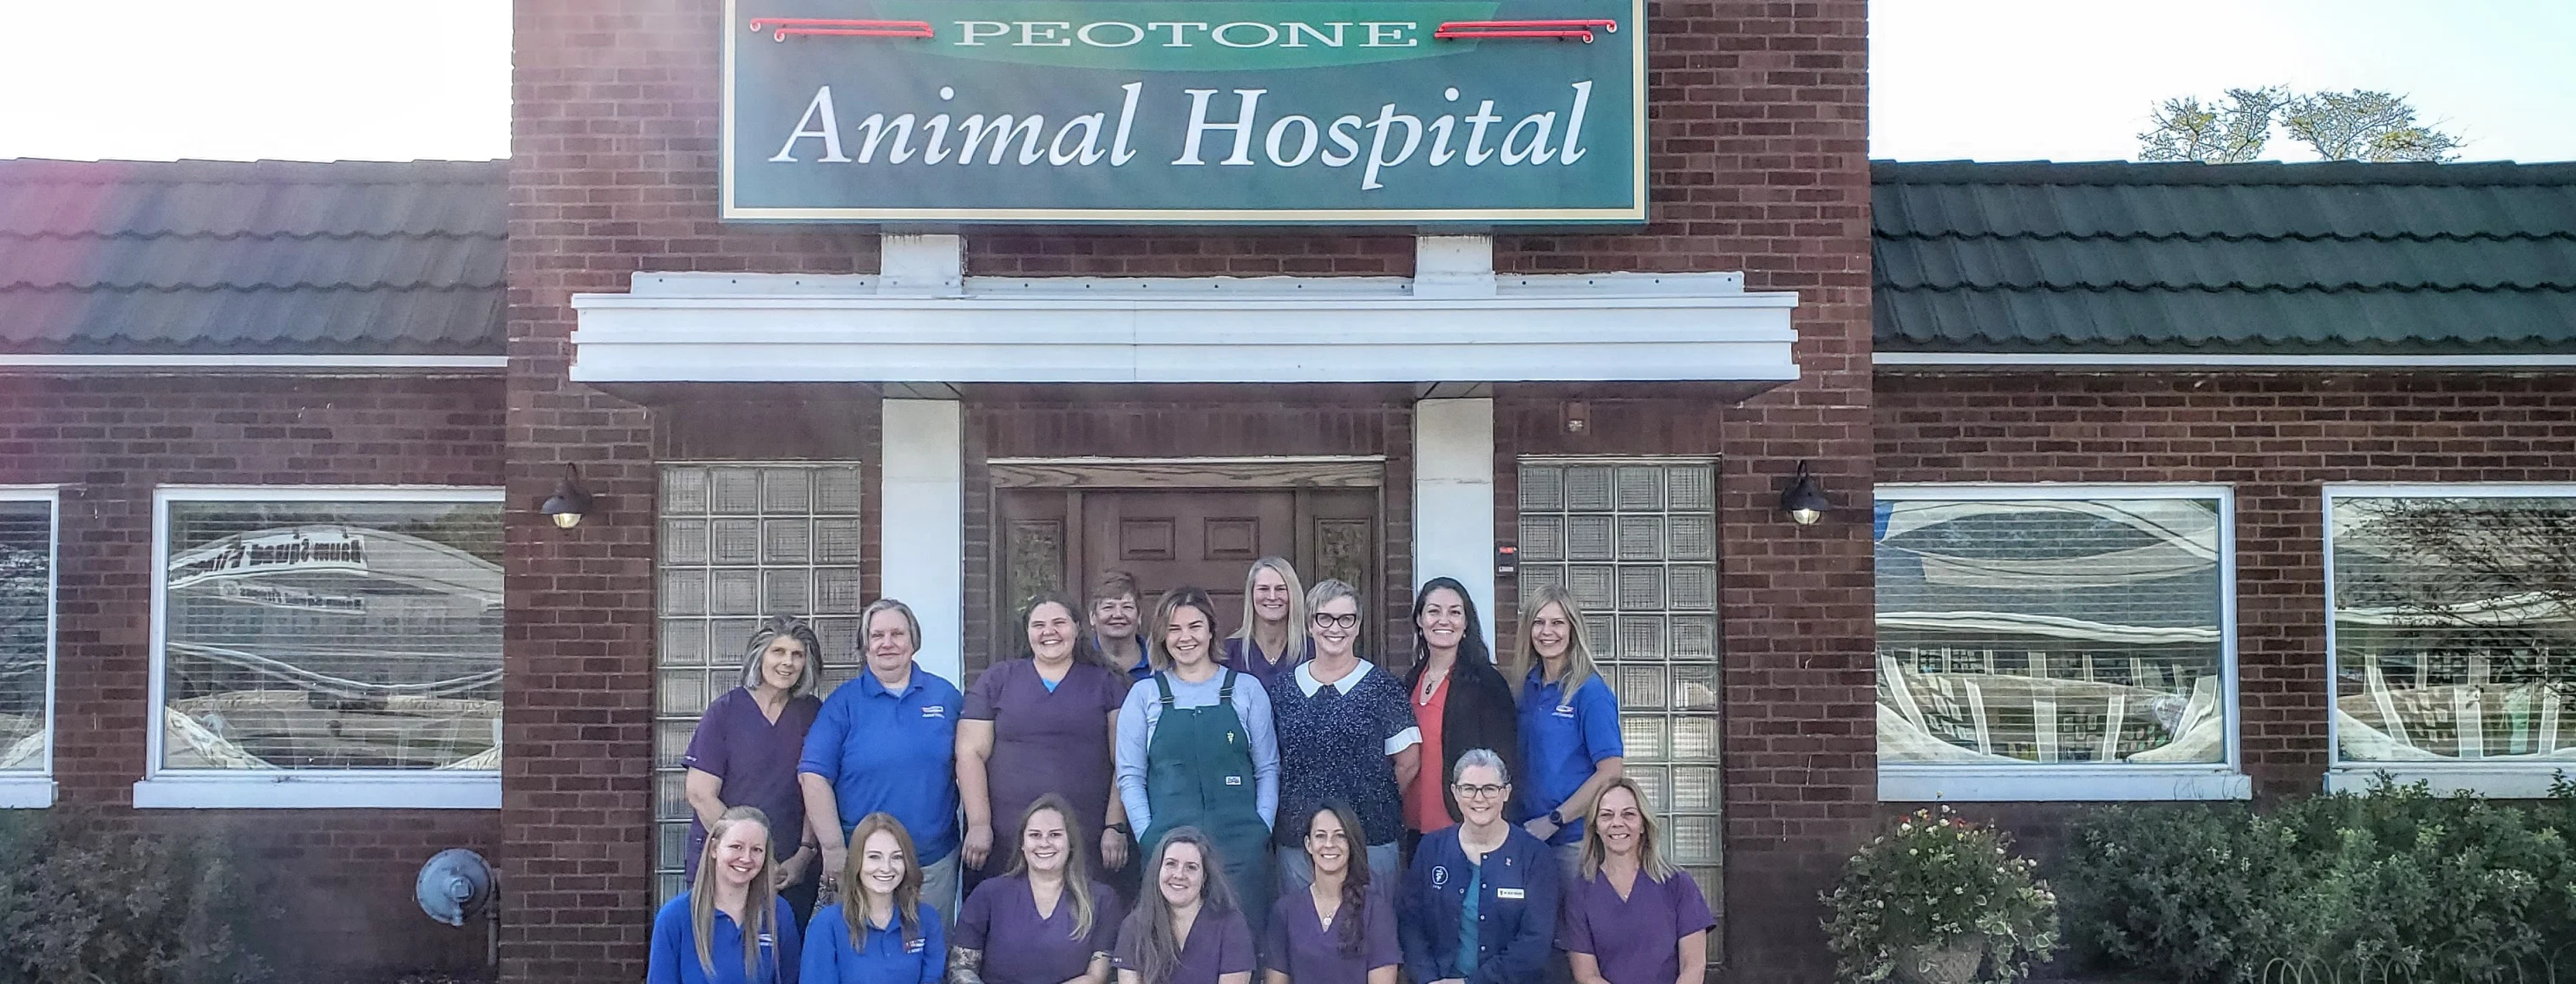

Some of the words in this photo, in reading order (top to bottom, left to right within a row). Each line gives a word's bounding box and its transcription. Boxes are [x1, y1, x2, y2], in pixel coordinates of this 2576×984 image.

[954, 21, 1417, 48] PEOTONE
[769, 82, 1145, 167] Animal
[1171, 80, 1595, 190] Hospital
